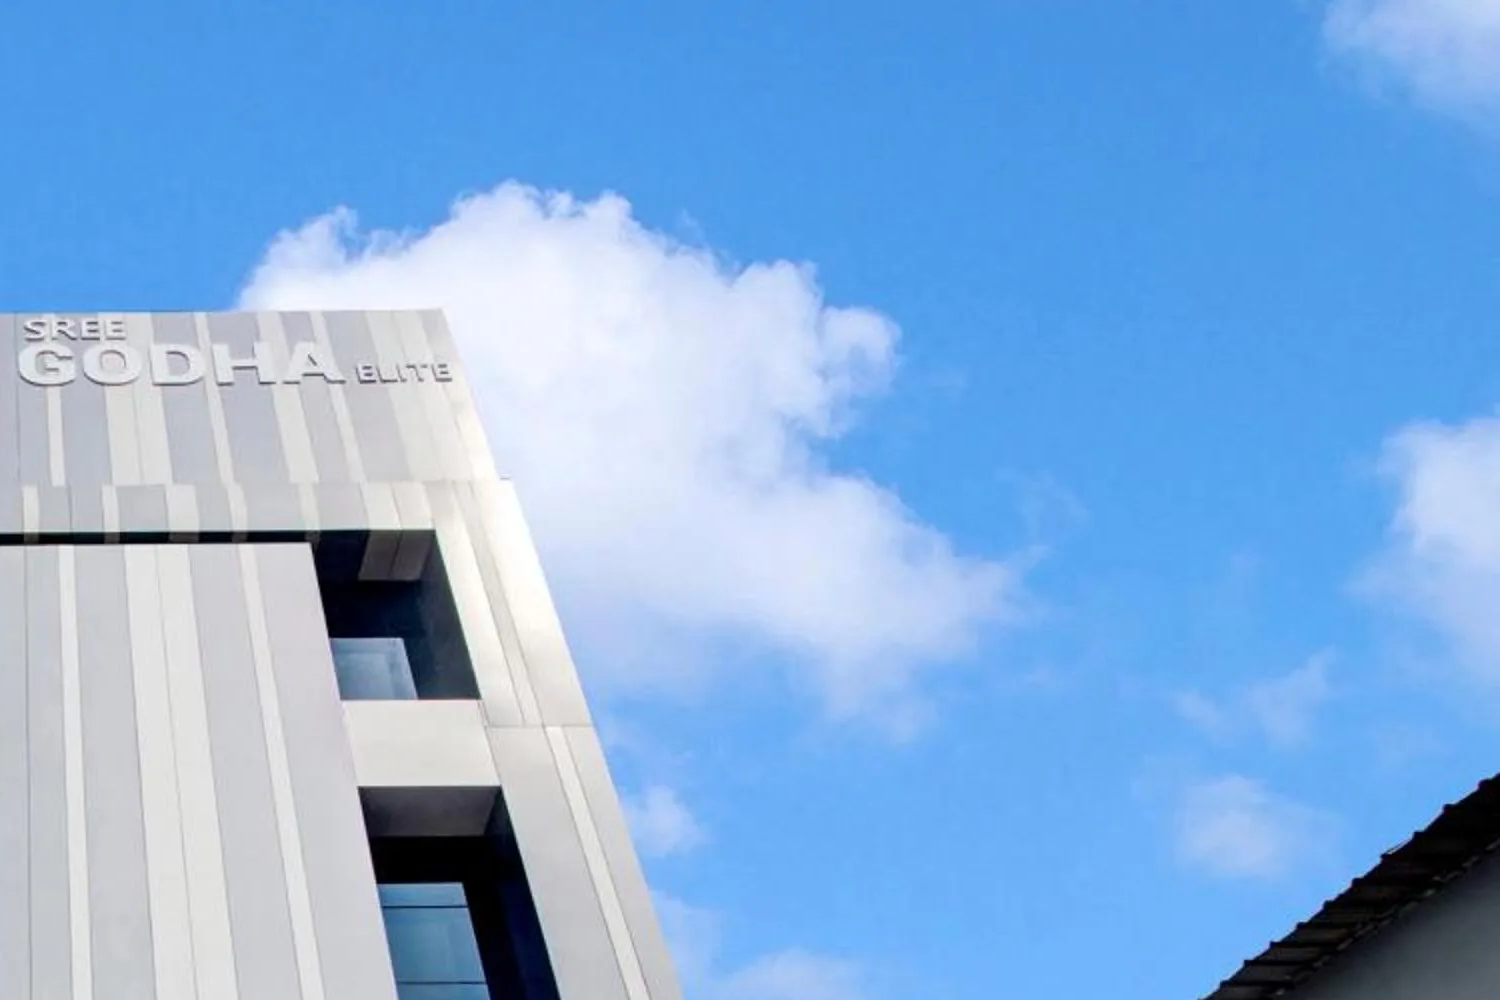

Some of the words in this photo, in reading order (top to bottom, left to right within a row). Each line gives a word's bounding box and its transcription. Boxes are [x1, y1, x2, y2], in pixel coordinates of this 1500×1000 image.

[22, 318, 127, 342] SREE
[17, 342, 345, 387] GODHA
[355, 362, 453, 385] ELITE
